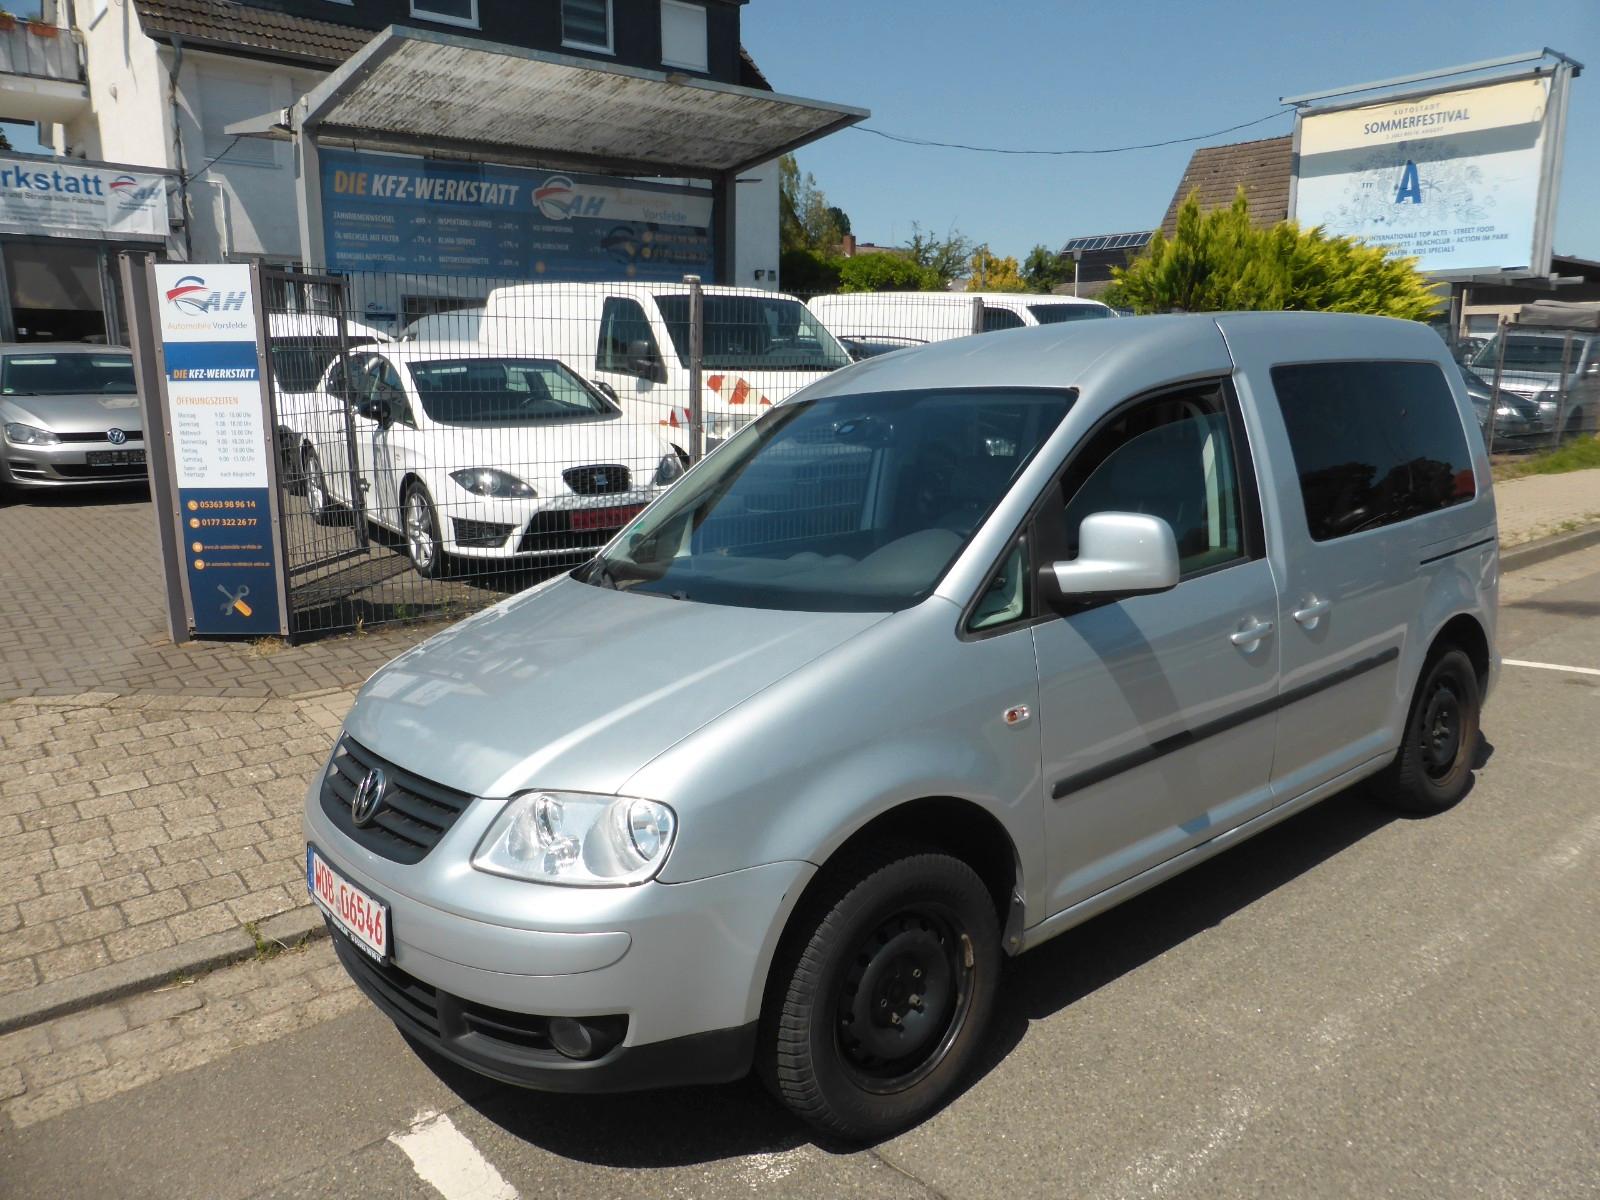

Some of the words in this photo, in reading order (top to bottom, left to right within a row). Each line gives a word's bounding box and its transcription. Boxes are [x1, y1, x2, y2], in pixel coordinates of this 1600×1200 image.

[1363, 108, 1470, 135] SOMMERFESTIVAL
[0, 165, 104, 196] rkstatt
[334, 170, 367, 195] DIE
[371, 174, 519, 206] KFZ-WERKSTATT
[1395, 159, 1421, 204] A
[568, 196, 605, 216] AH
[1419, 231, 1431, 239] TOP
[1433, 229, 1448, 237] ACTS
[1453, 227, 1475, 235] STREET
[1456, 235, 1481, 243] ACTION
[204, 291, 247, 311] AH
[212, 321, 248, 329] Vorsfelde
[174, 369, 188, 379] DIE
[189, 368, 255, 379] KFZ-WERKSTATT
[200, 500, 223, 509] 05363
[224, 500, 236, 509] 98
[236, 500, 245, 508] 96
[247, 500, 256, 508] 14
[315, 859, 334, 905] WOB
[340, 884, 383, 946] 06546
